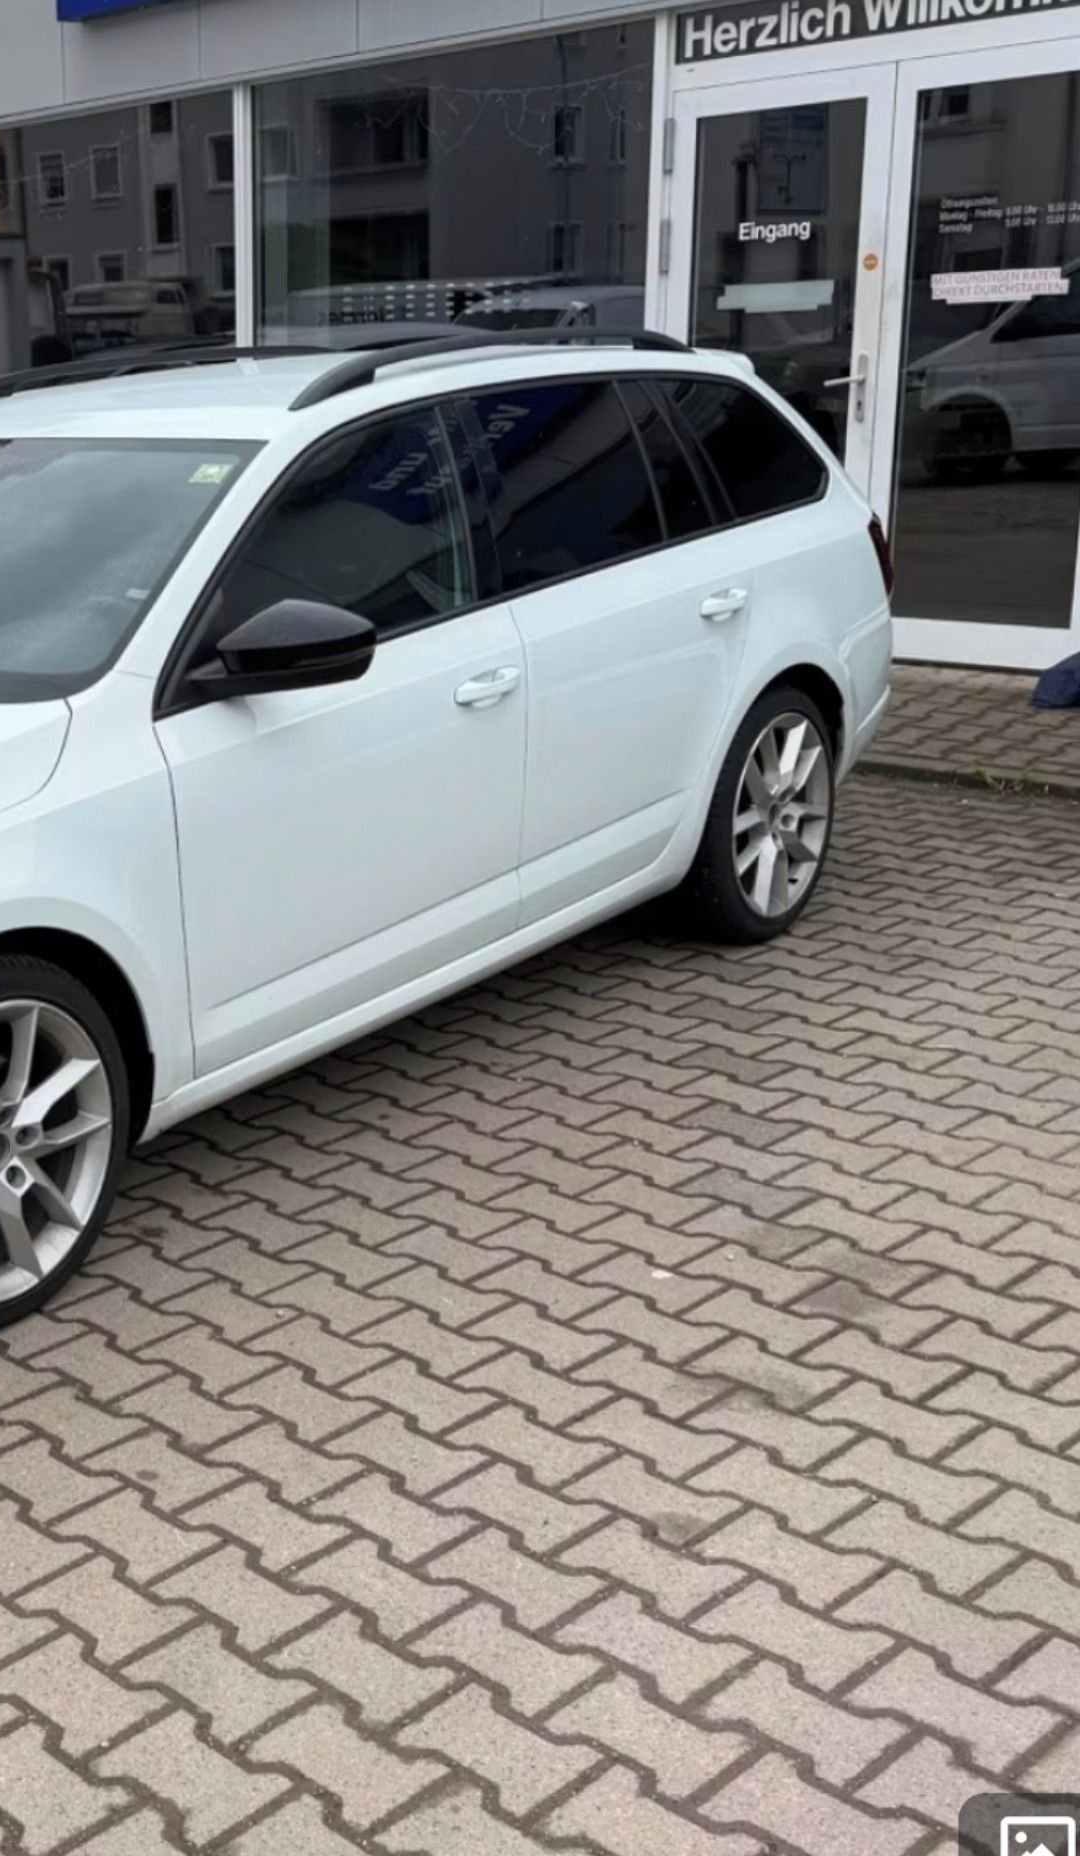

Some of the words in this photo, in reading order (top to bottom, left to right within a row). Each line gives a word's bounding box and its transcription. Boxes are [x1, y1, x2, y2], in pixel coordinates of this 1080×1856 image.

[683, 0, 851, 59] Herzlich
[864, 0, 1070, 31] Willko
[738, 221, 812, 243] Eingang
